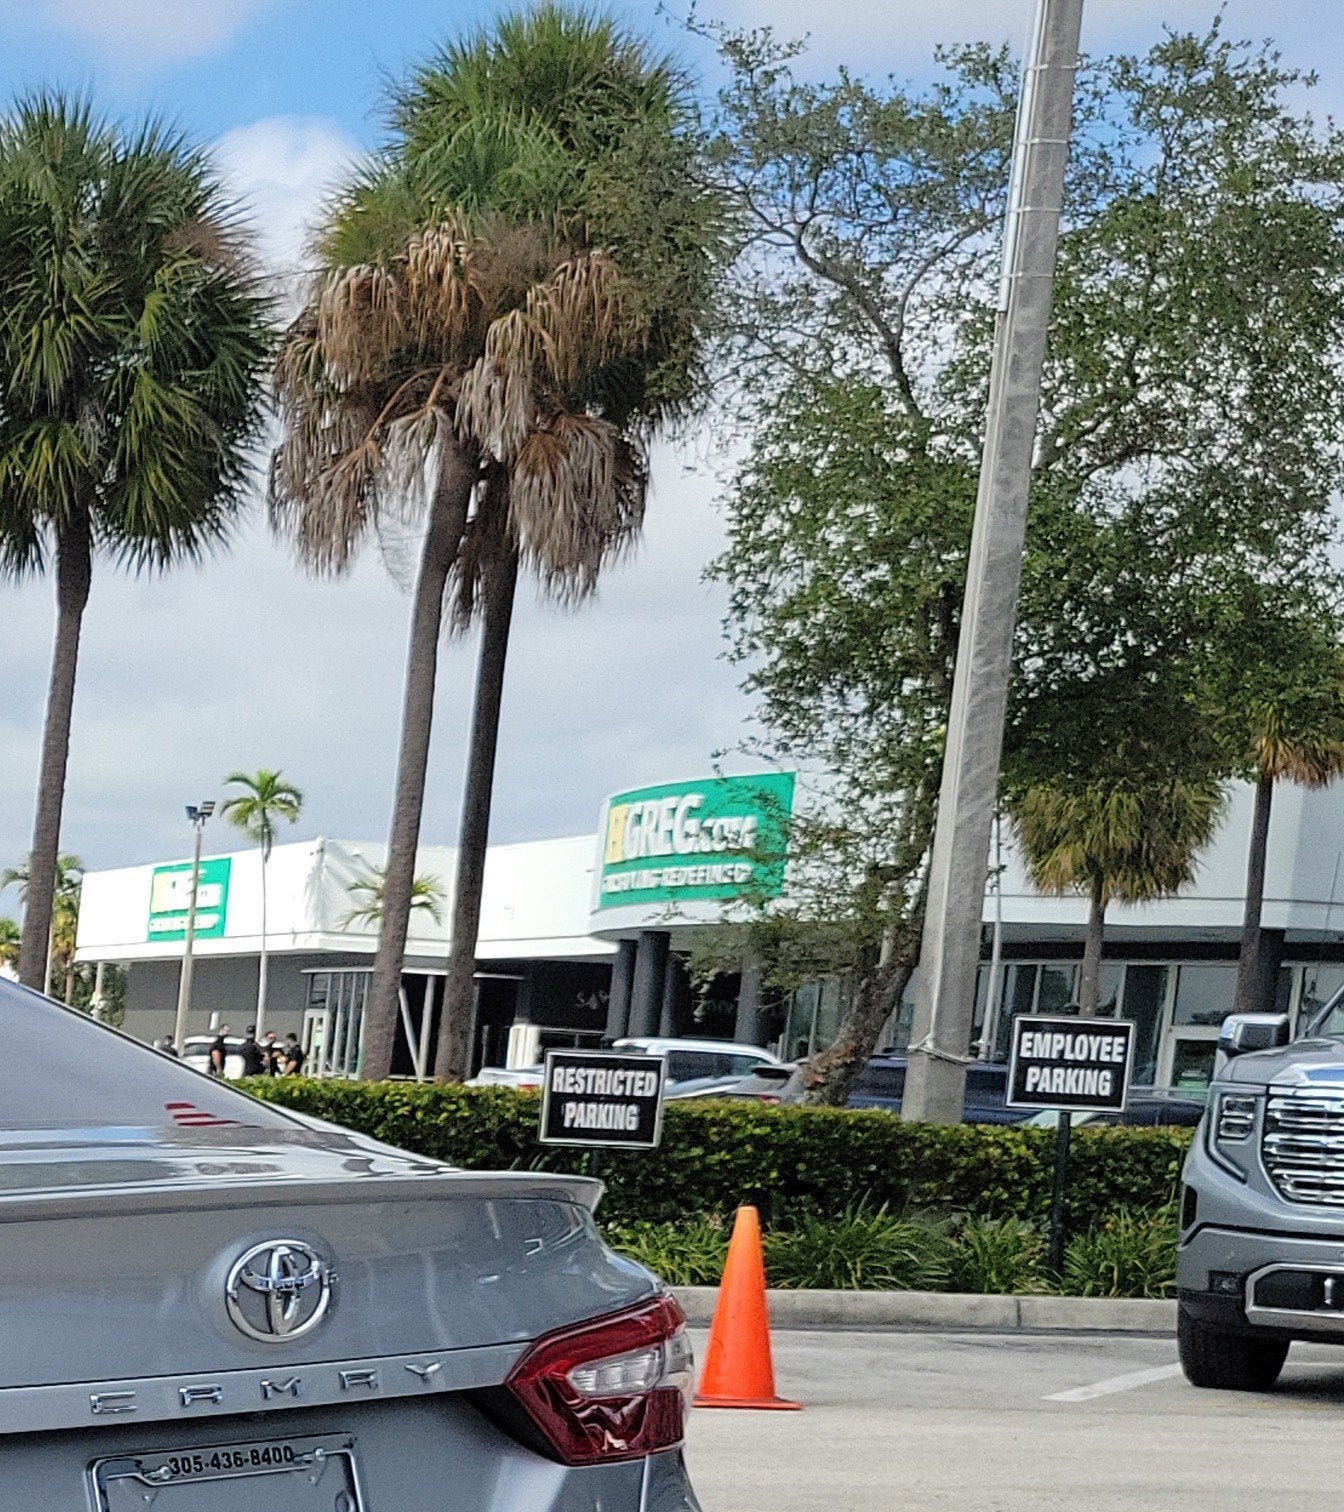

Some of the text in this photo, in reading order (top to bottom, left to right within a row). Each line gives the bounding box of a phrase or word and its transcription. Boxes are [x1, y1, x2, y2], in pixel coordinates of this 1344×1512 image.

[1019, 1031, 1127, 1063] EMPLOYEE
[551, 1065, 658, 1097] RESTRICTED
[1025, 1065, 1112, 1097] PARKING
[563, 1101, 641, 1131] PARKING
[89, 1359, 447, 1415] CAMRY
[168, 1445, 295, 1475] 305-436-8400
